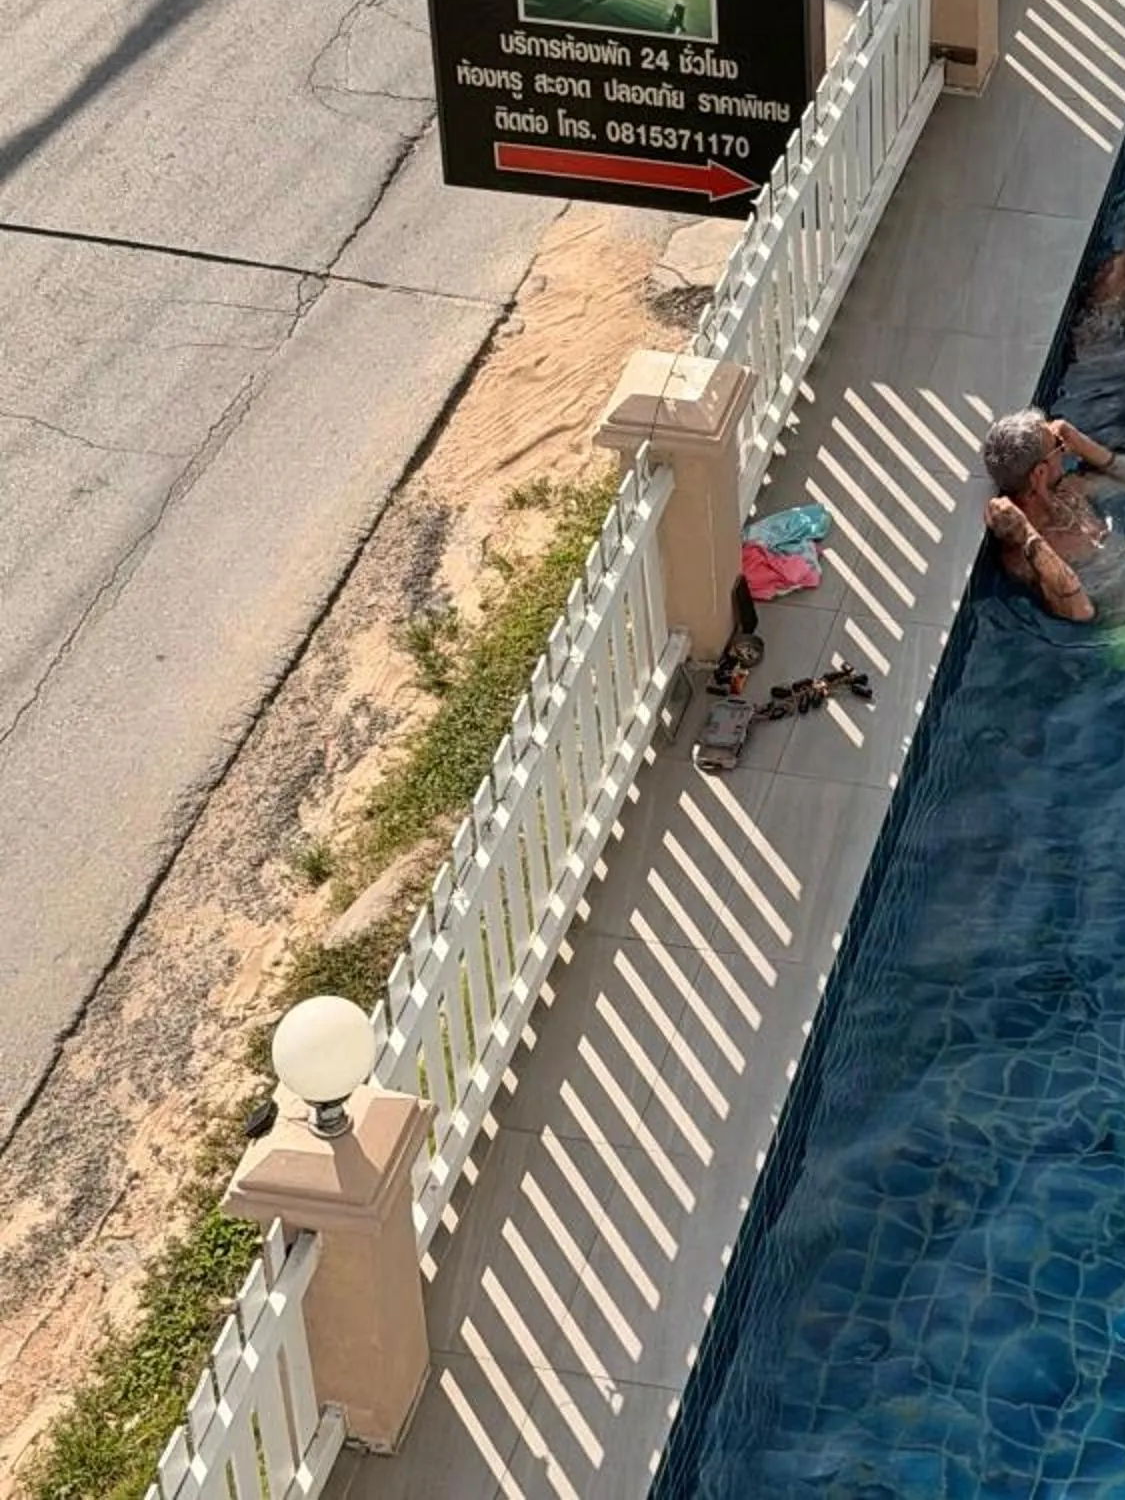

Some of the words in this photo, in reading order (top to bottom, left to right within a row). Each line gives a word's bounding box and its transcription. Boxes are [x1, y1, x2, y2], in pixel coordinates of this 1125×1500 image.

[500, 29, 632, 67] บริการห้องพัก
[640, 47, 671, 72] 24
[678, 43, 739, 79] ชั่วโมง
[456, 58, 523, 100] ห้องหรู
[534, 72, 592, 99] สะอาด
[604, 77, 686, 110] ปลอดภัย
[698, 92, 792, 123] ราคาพิเศษ
[494, 105, 549, 135] ติดต่อ
[556, 107, 598, 141] โทร.
[606, 120, 750, 159] 0815371170
